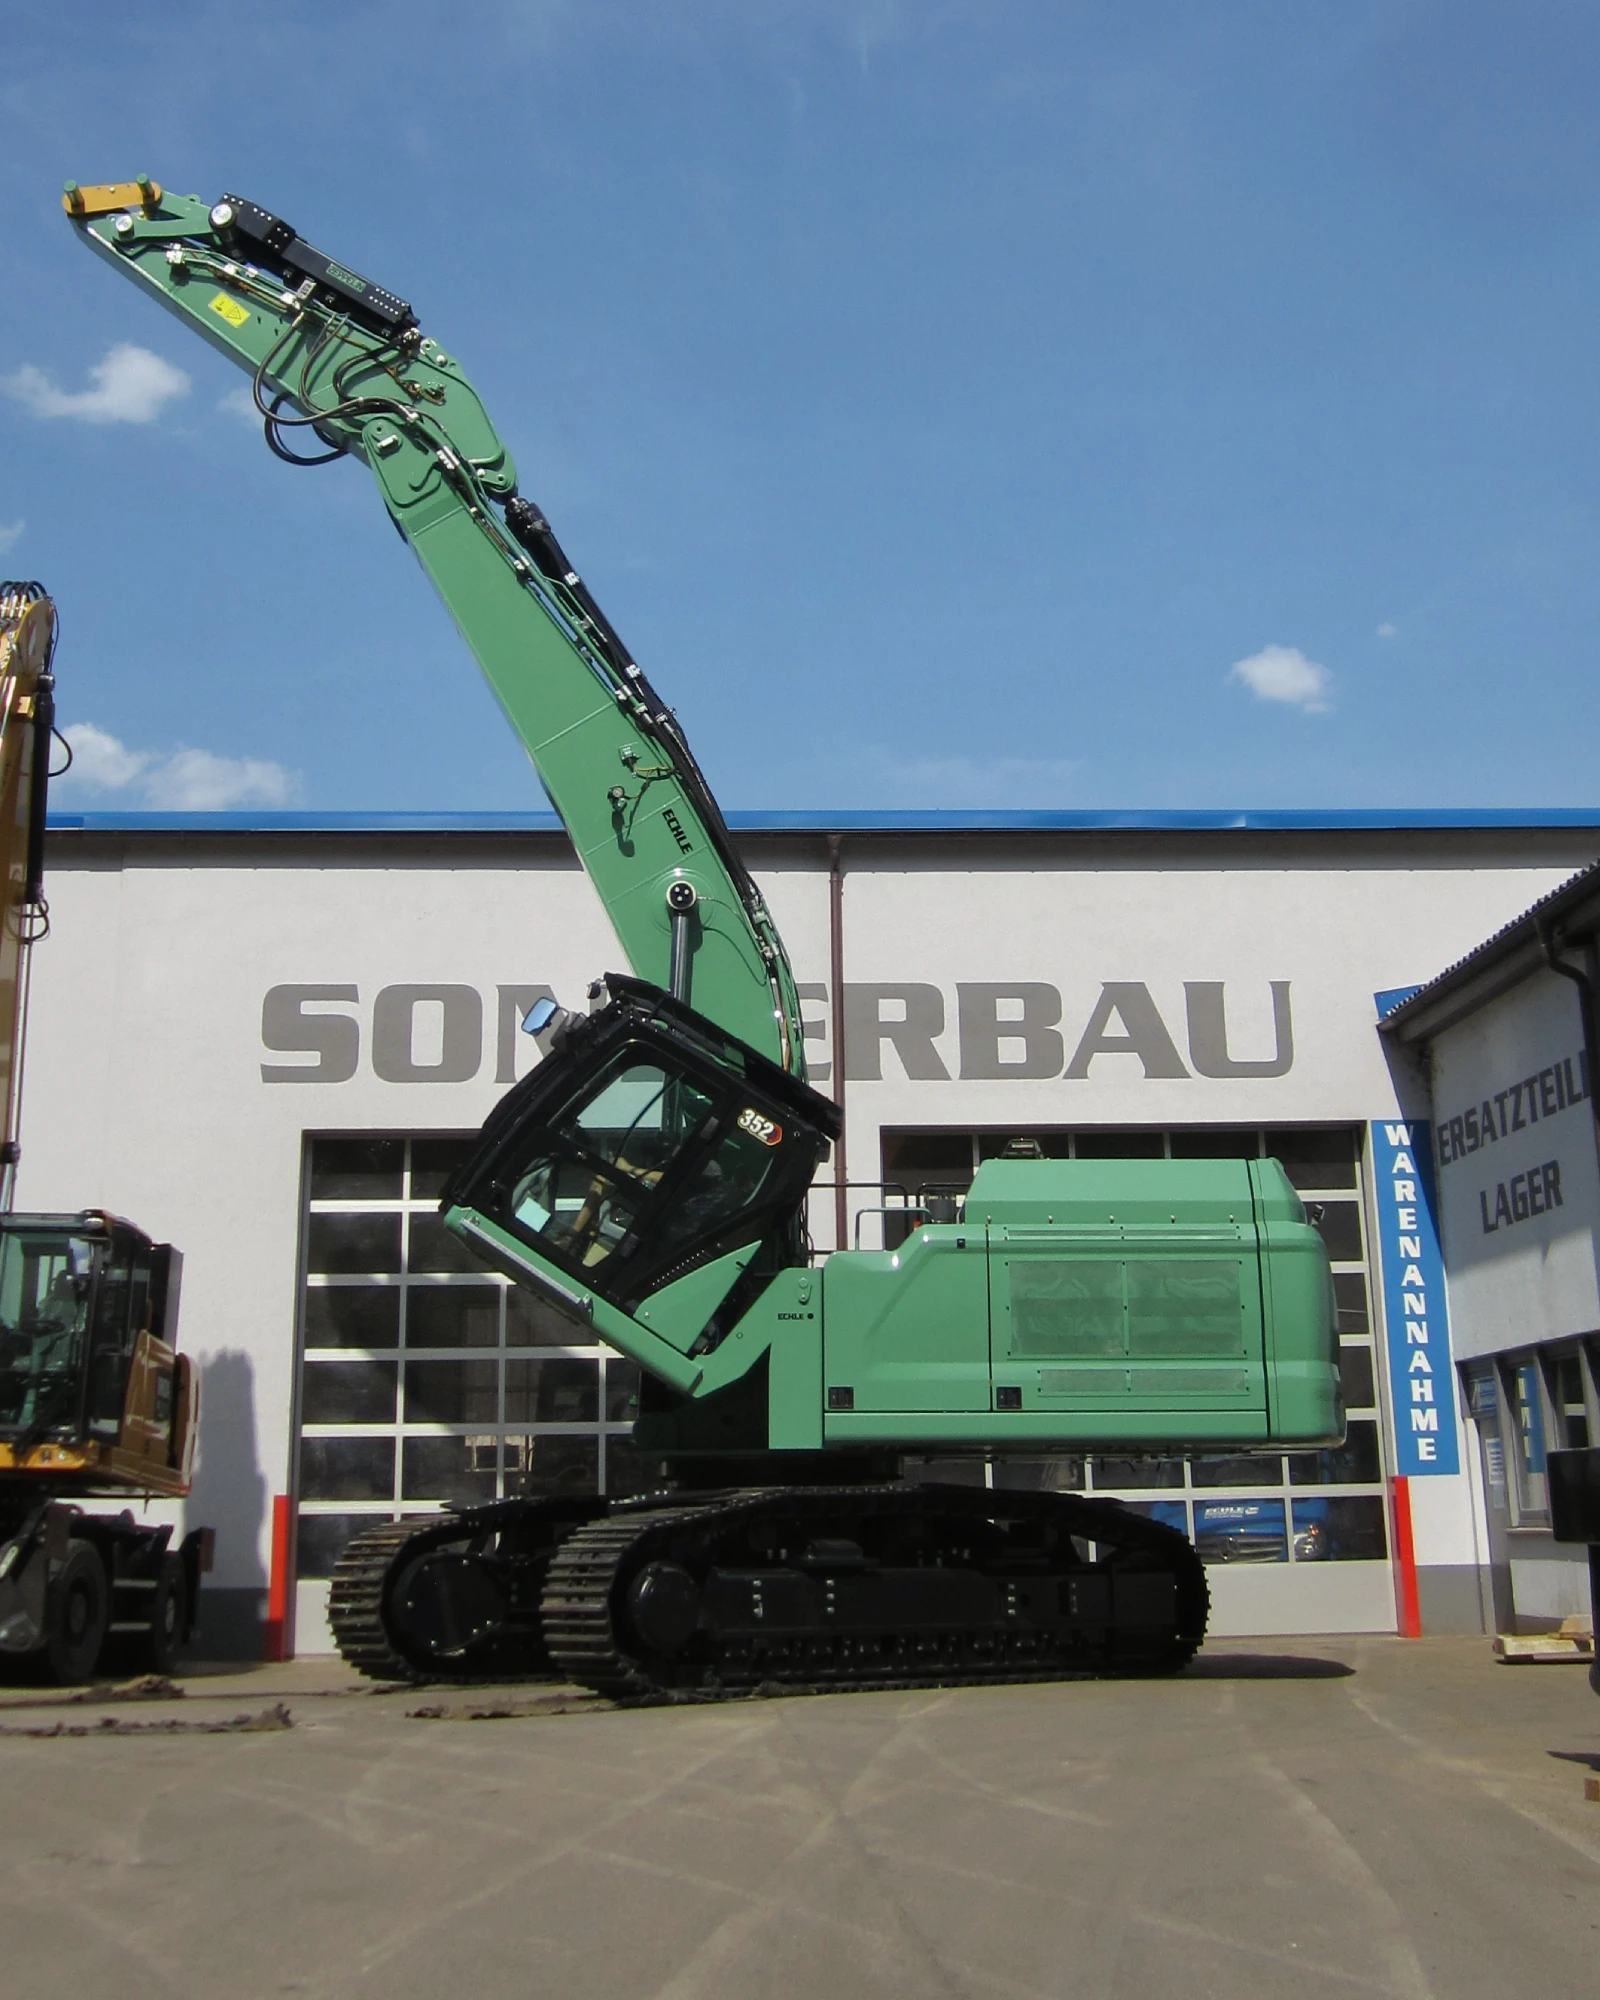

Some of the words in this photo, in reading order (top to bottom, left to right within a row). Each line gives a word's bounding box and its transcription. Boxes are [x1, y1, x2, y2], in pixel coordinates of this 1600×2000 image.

[661, 807, 694, 855] ECHLE
[260, 980, 1294, 1083] SONRBAU
[739, 1108, 775, 1141] 352
[1479, 1159, 1564, 1235] LAGER
[777, 1312, 804, 1321] ECHLE
[1384, 1123, 1439, 1461] WARENANNAHME
